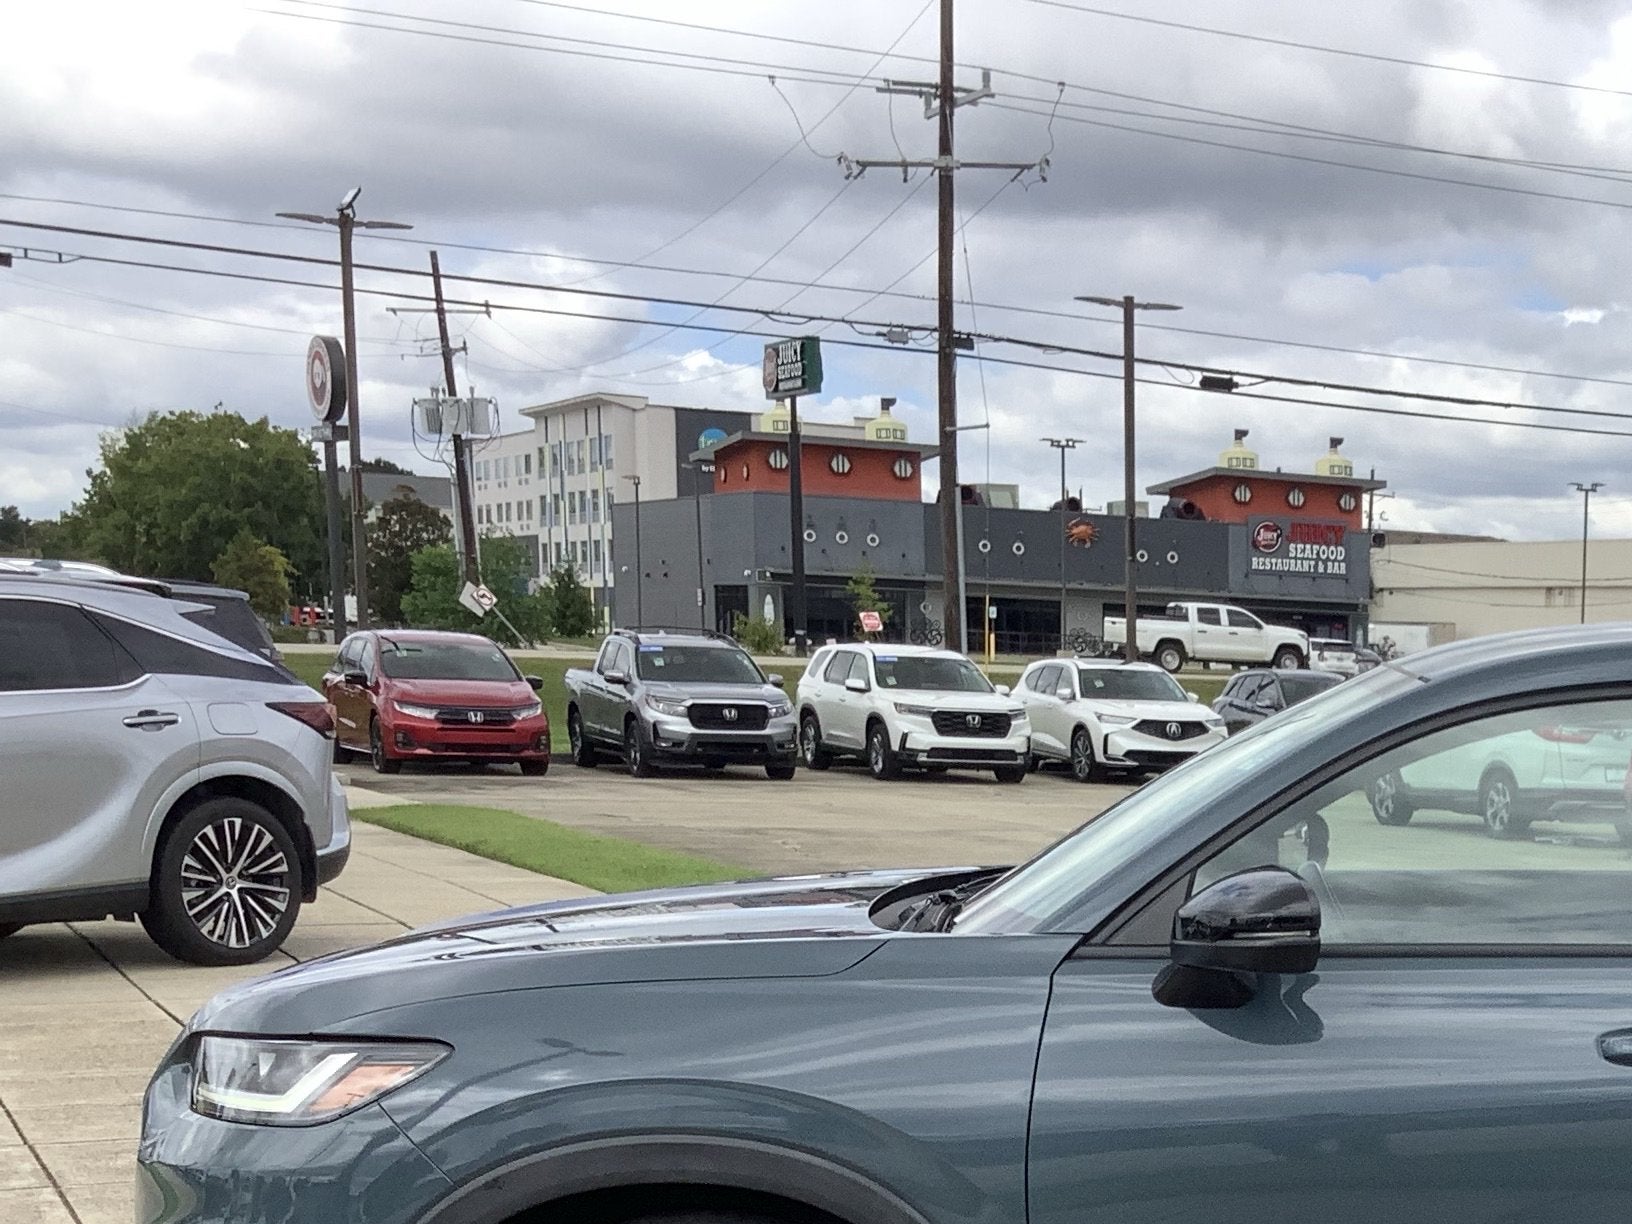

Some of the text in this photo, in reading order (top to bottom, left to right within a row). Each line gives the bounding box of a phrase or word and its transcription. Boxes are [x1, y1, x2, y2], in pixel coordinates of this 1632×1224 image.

[777, 340, 802, 366] JUICY
[777, 361, 802, 380] SEAFOOD
[1286, 523, 1346, 545] JUICY
[1288, 543, 1346, 560] SEAFOOD
[1251, 557, 1347, 574] RESTAURANT & BAR
